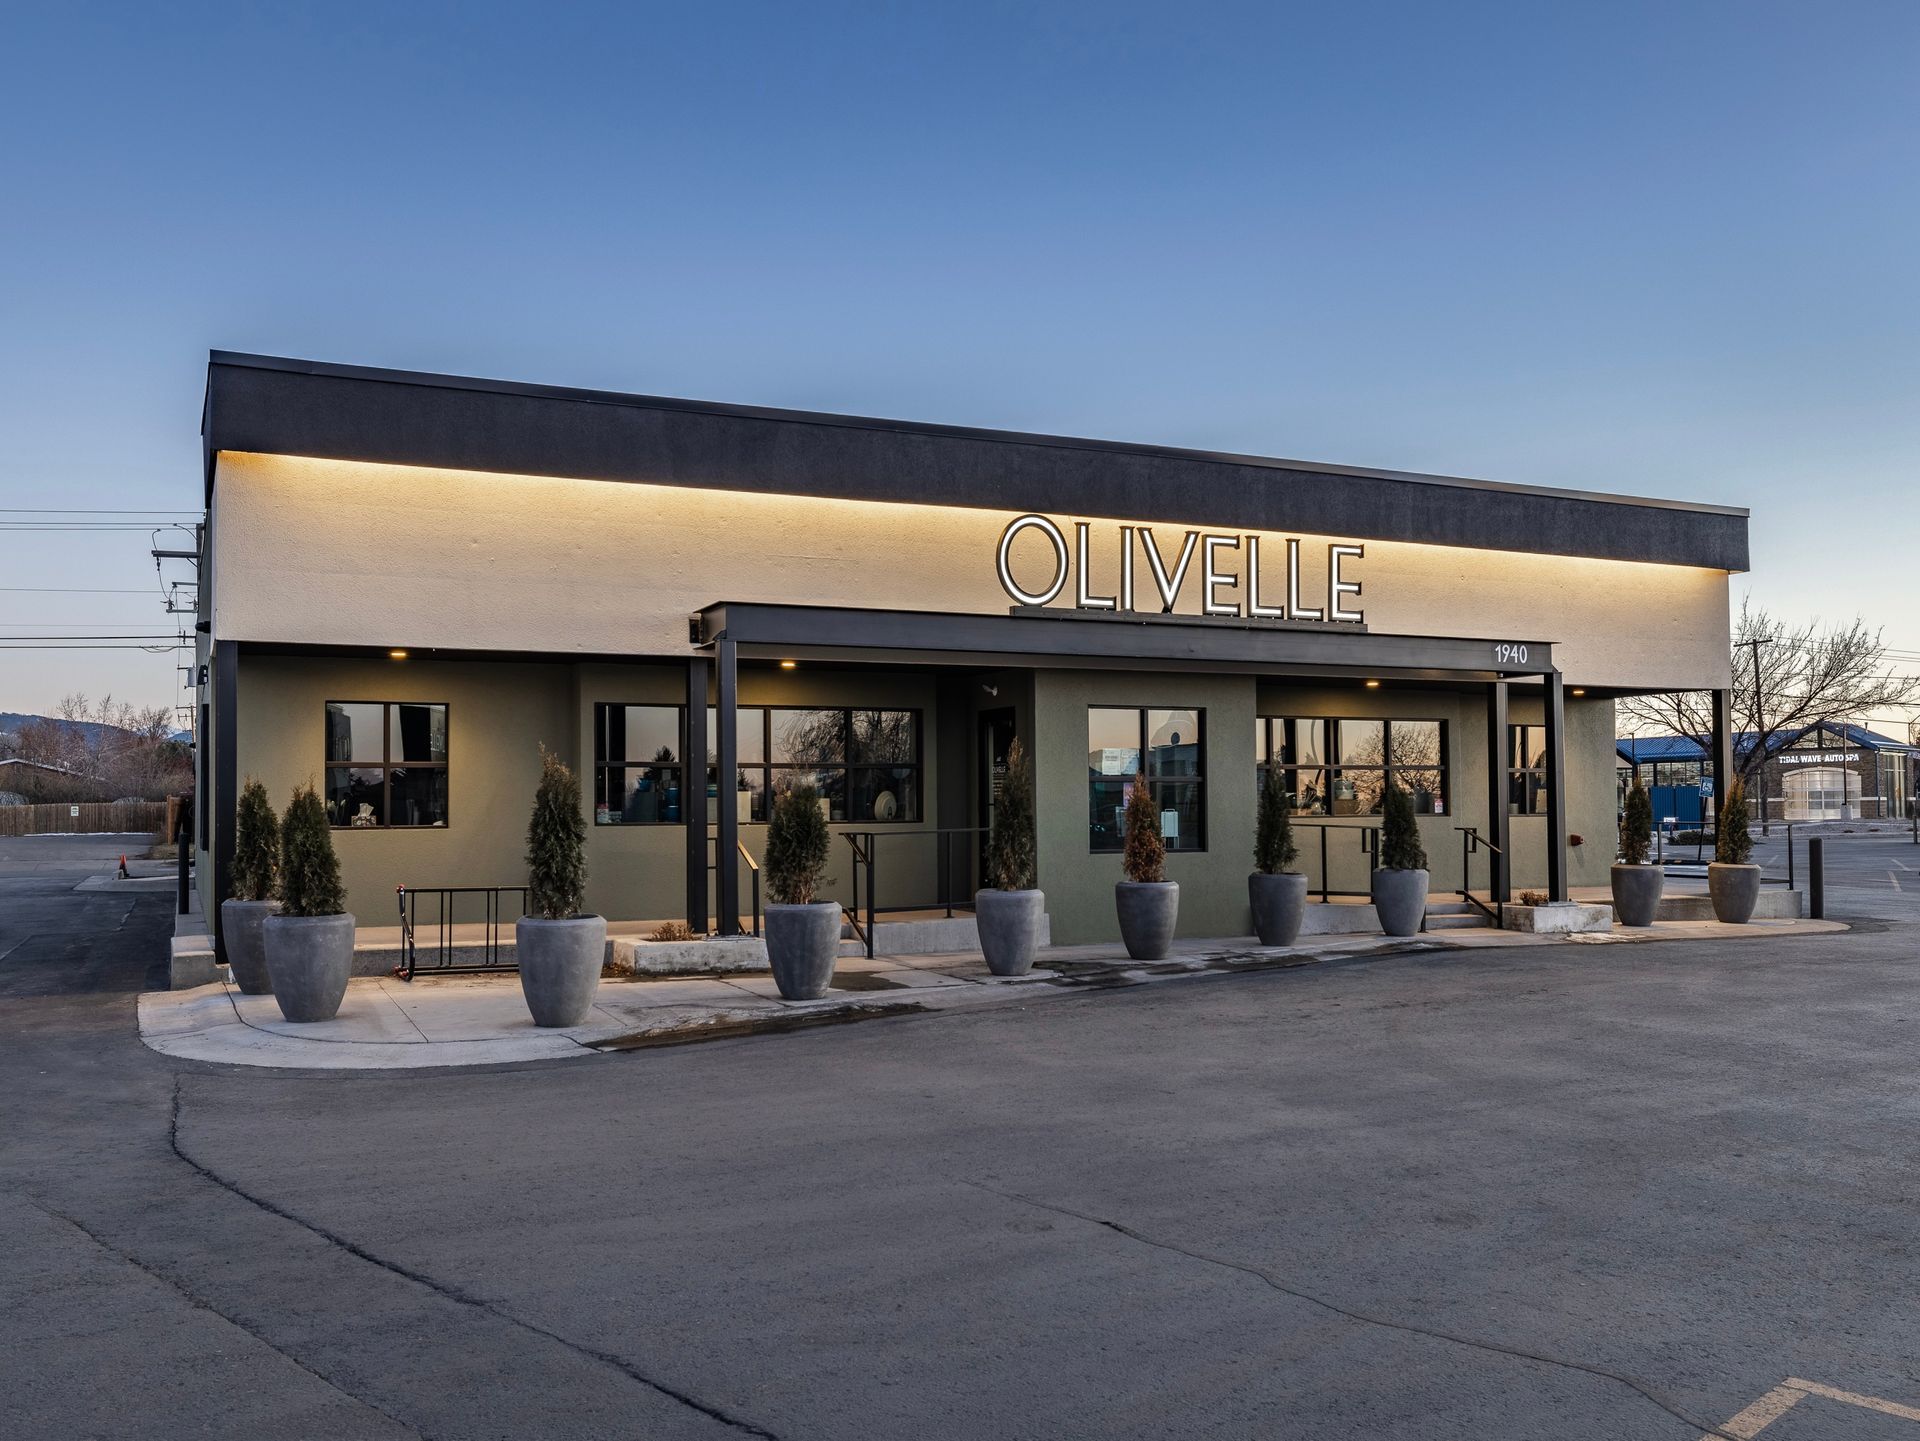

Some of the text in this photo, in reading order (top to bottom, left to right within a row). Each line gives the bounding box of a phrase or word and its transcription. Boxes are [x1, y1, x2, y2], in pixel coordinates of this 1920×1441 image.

[996, 514, 1365, 623] OLIVELLE
[1495, 644, 1528, 664] 1940
[1778, 753, 1859, 764] TIDAL WAVE AUTO SPA
